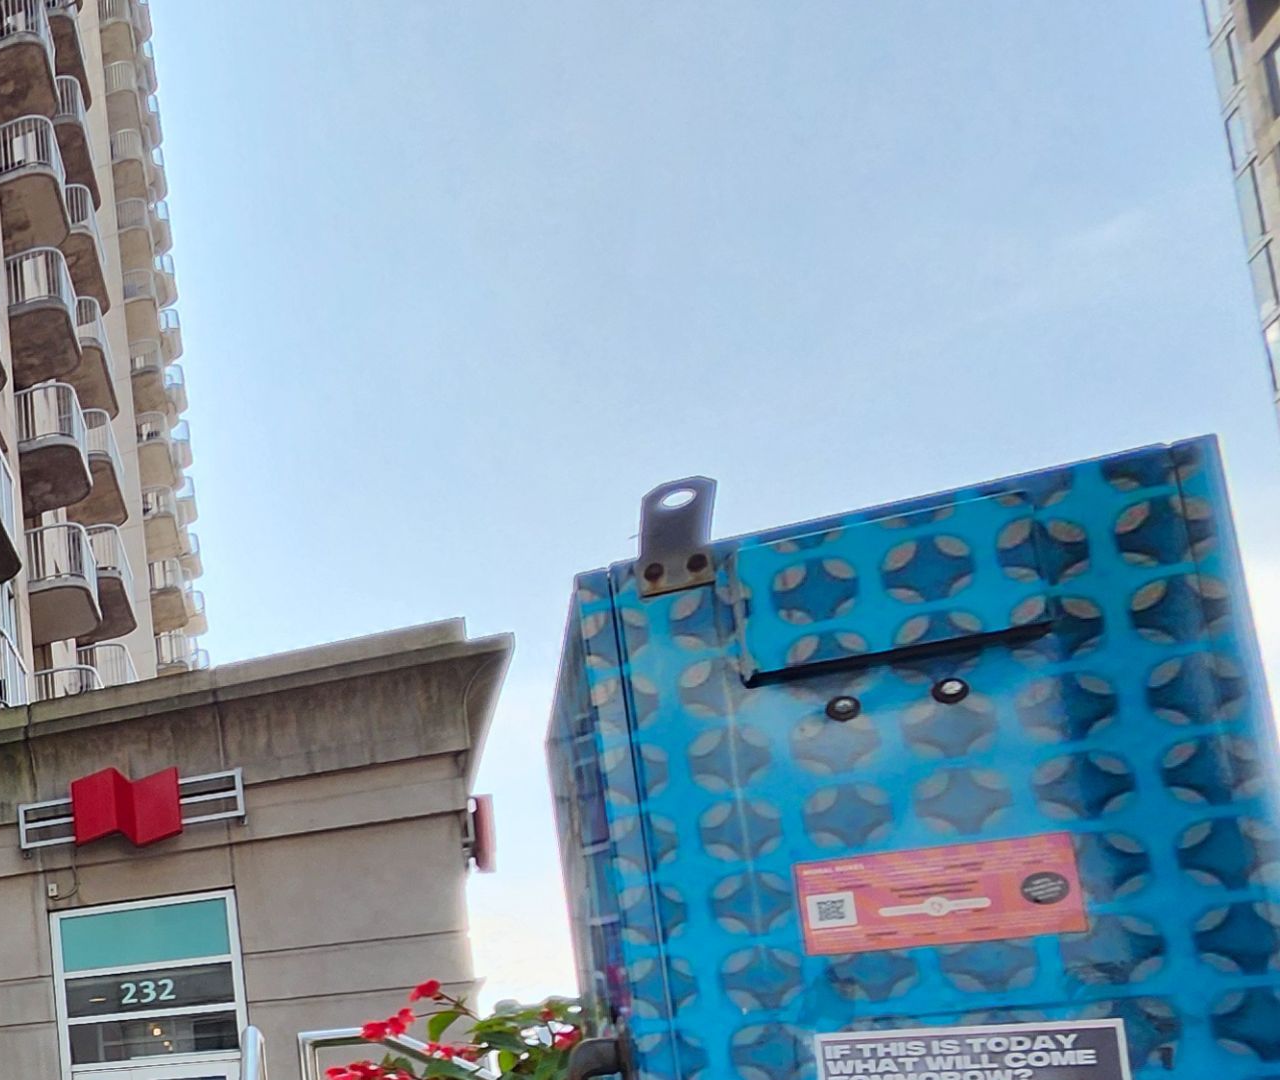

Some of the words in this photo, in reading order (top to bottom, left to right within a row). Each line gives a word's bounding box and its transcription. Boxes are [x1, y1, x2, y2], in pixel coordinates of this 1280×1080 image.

[120, 978, 177, 1005] 232
[824, 1044, 851, 1060] IF
[856, 1040, 926, 1058] THIS
[932, 1038, 961, 1055] IS
[965, 1033, 1079, 1053] TODAY
[826, 1056, 920, 1075] WHAT
[924, 1053, 999, 1071] WILL
[1004, 1049, 1098, 1068] COME
